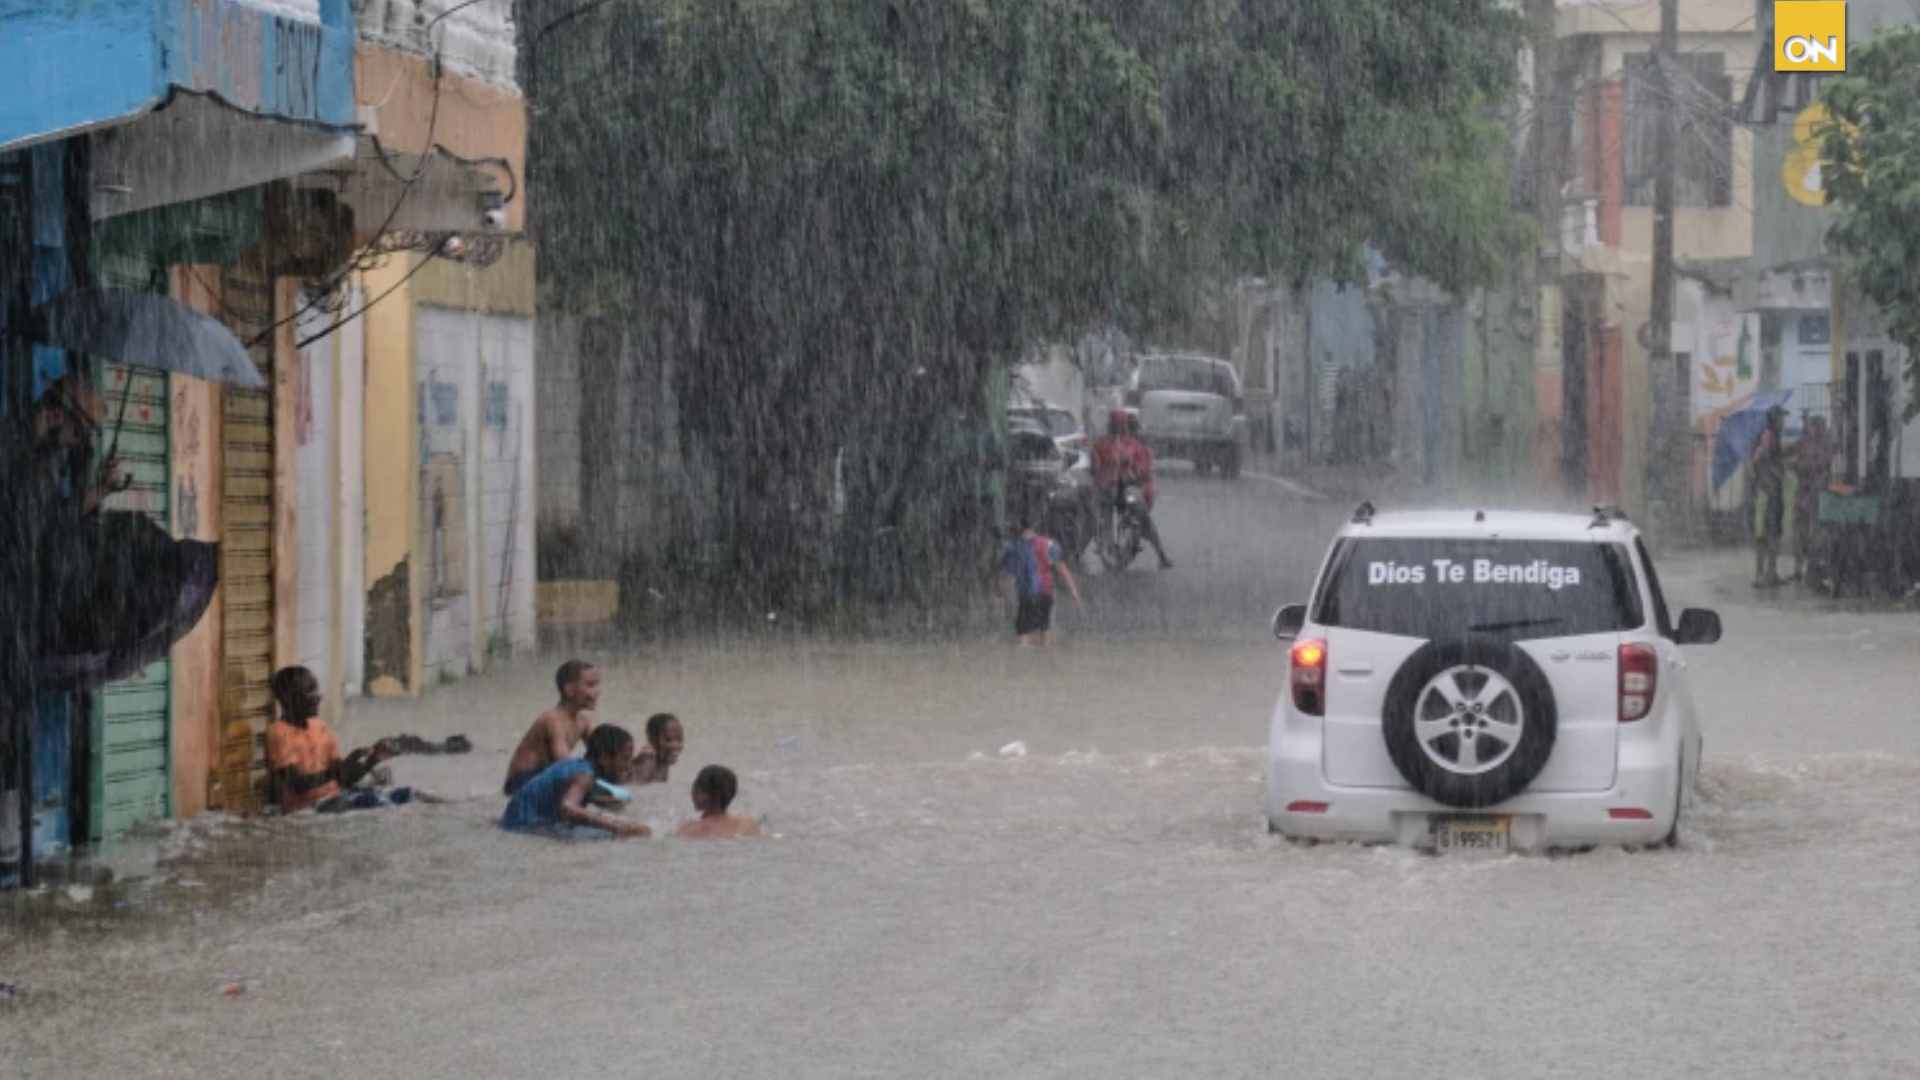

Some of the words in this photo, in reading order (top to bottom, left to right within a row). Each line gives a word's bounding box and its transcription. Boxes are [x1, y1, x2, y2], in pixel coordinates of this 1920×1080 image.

[1367, 561, 1425, 584] Dios
[1433, 560, 1465, 583] Te
[1473, 560, 1580, 589] Bendiga
